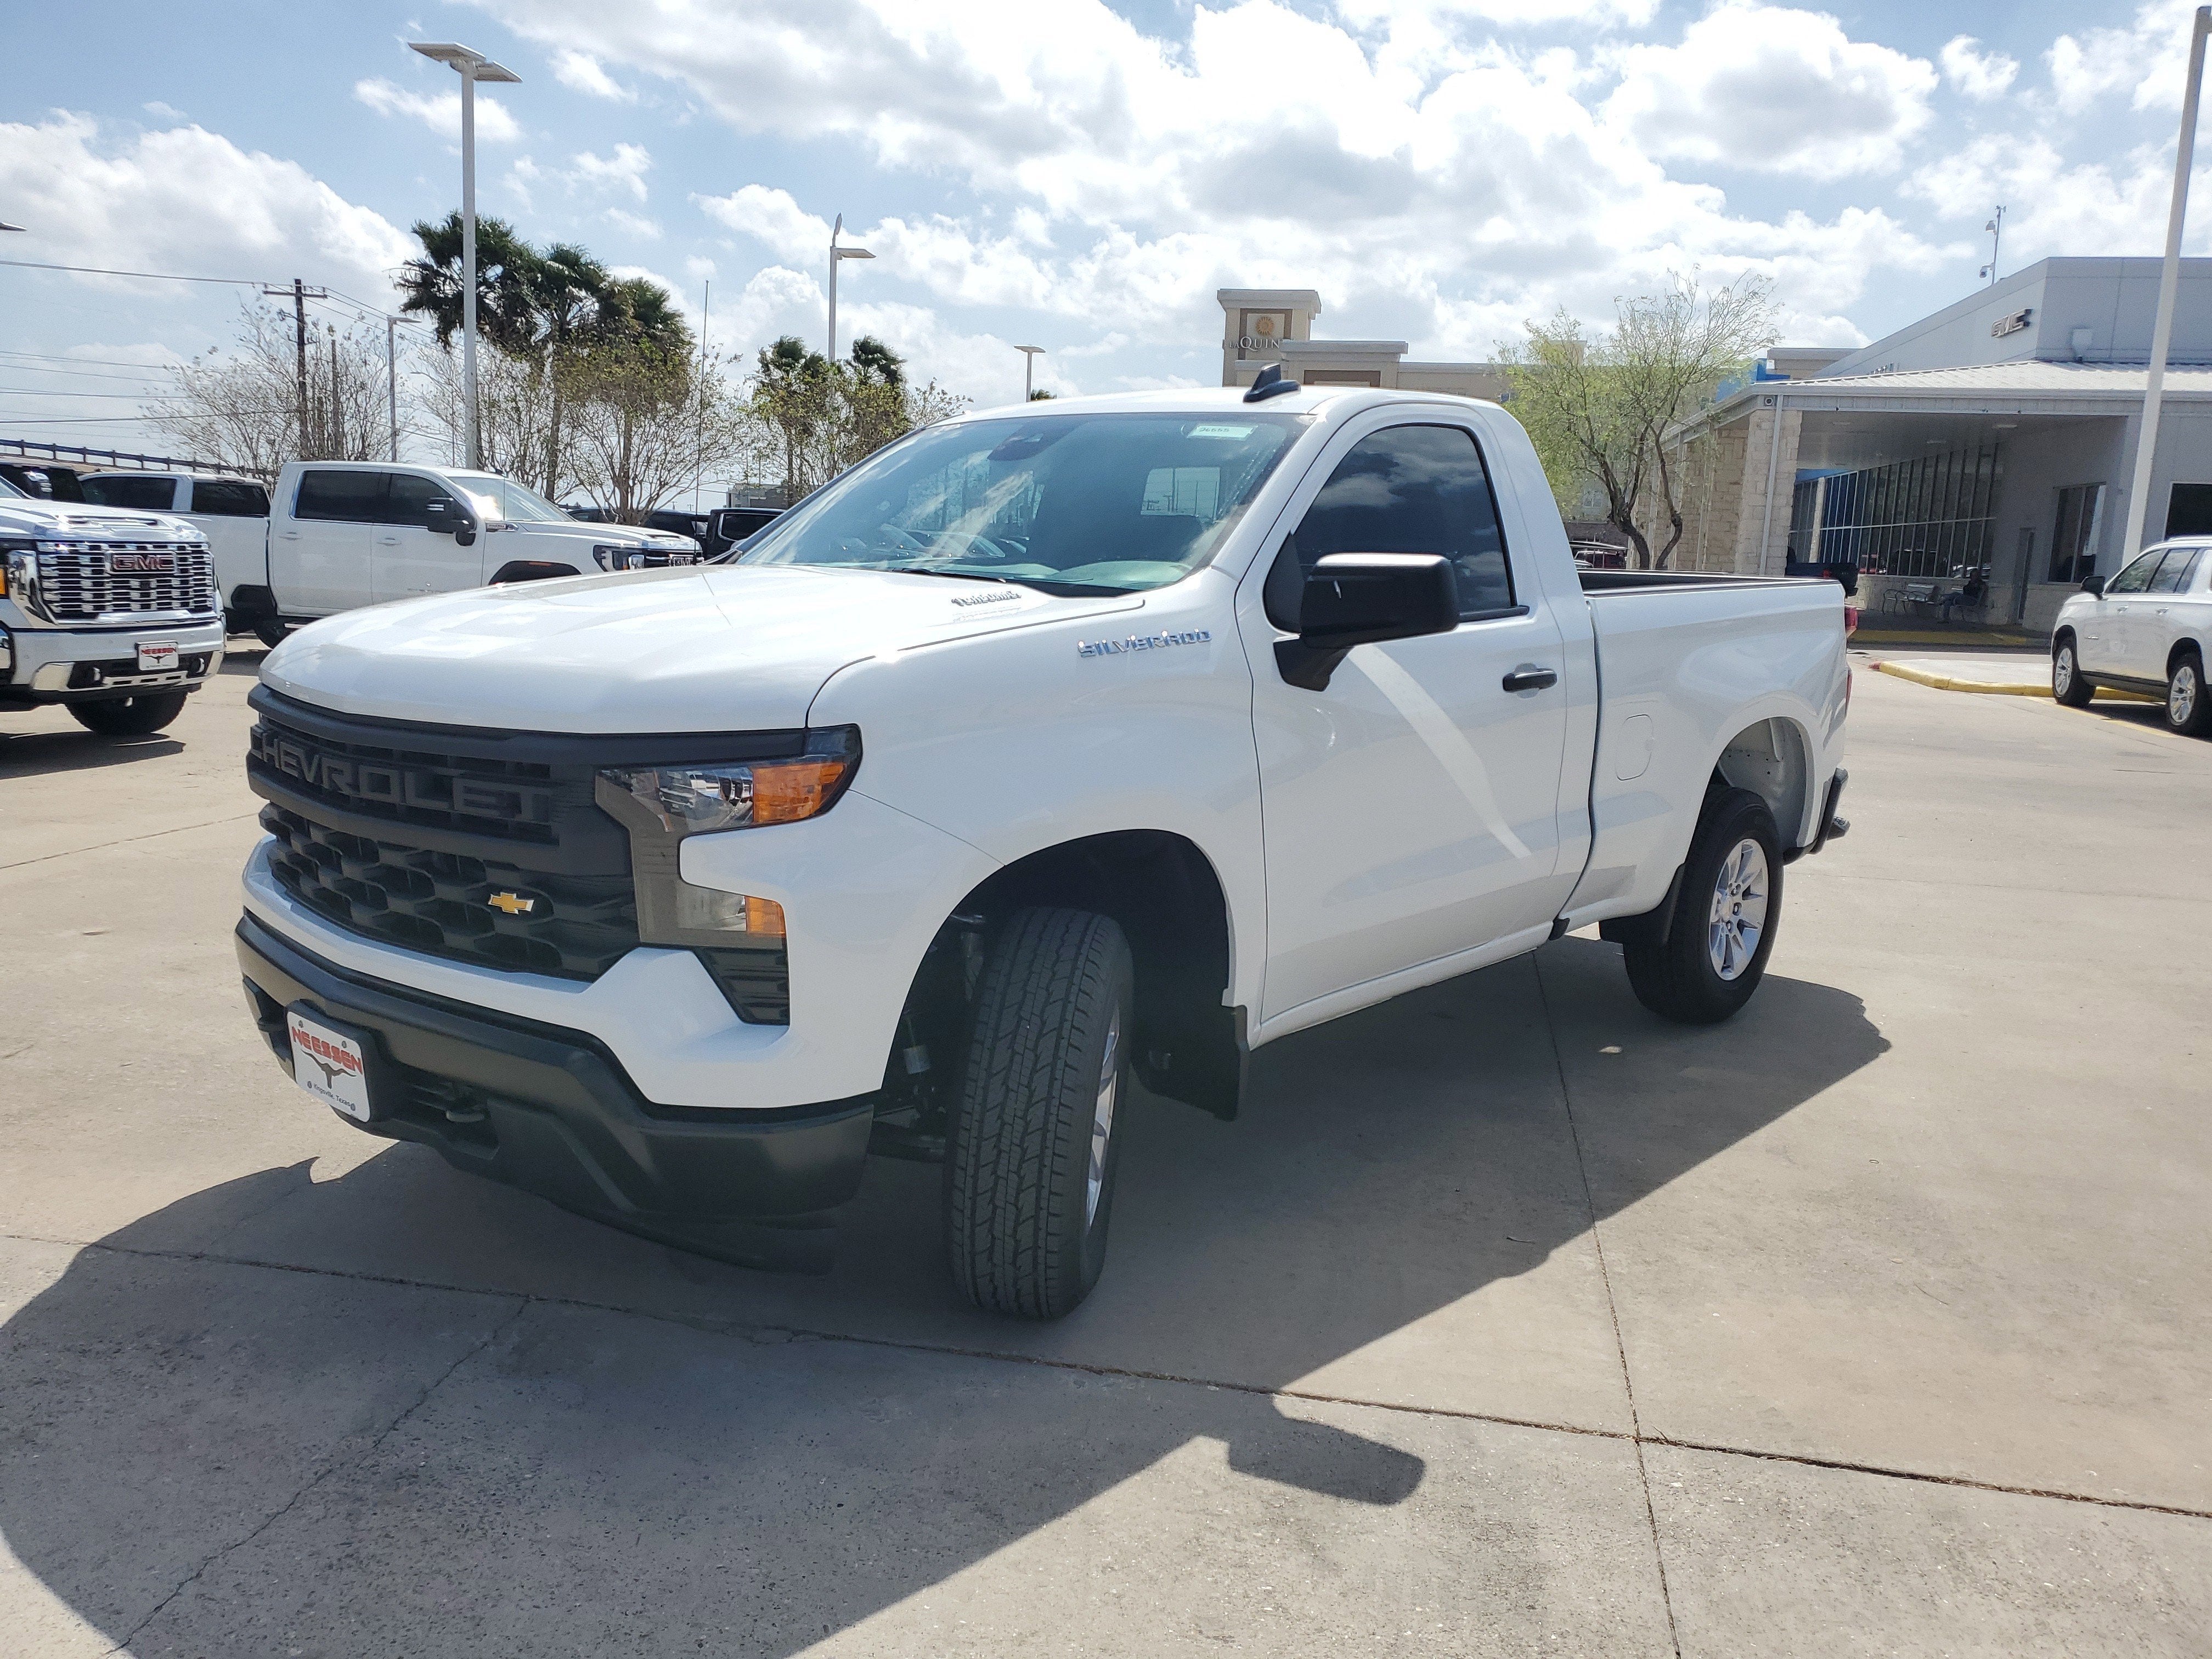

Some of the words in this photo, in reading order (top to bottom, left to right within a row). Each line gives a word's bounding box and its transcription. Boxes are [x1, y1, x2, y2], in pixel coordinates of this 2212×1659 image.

[1991, 308, 2032, 338] GMC
[1240, 336, 1282, 352] QUIN
[113, 554, 174, 570] GMC
[1077, 628, 1212, 658] SILVERADO
[250, 725, 551, 822] CHEVROLET
[292, 1026, 363, 1075] NEESSEN
